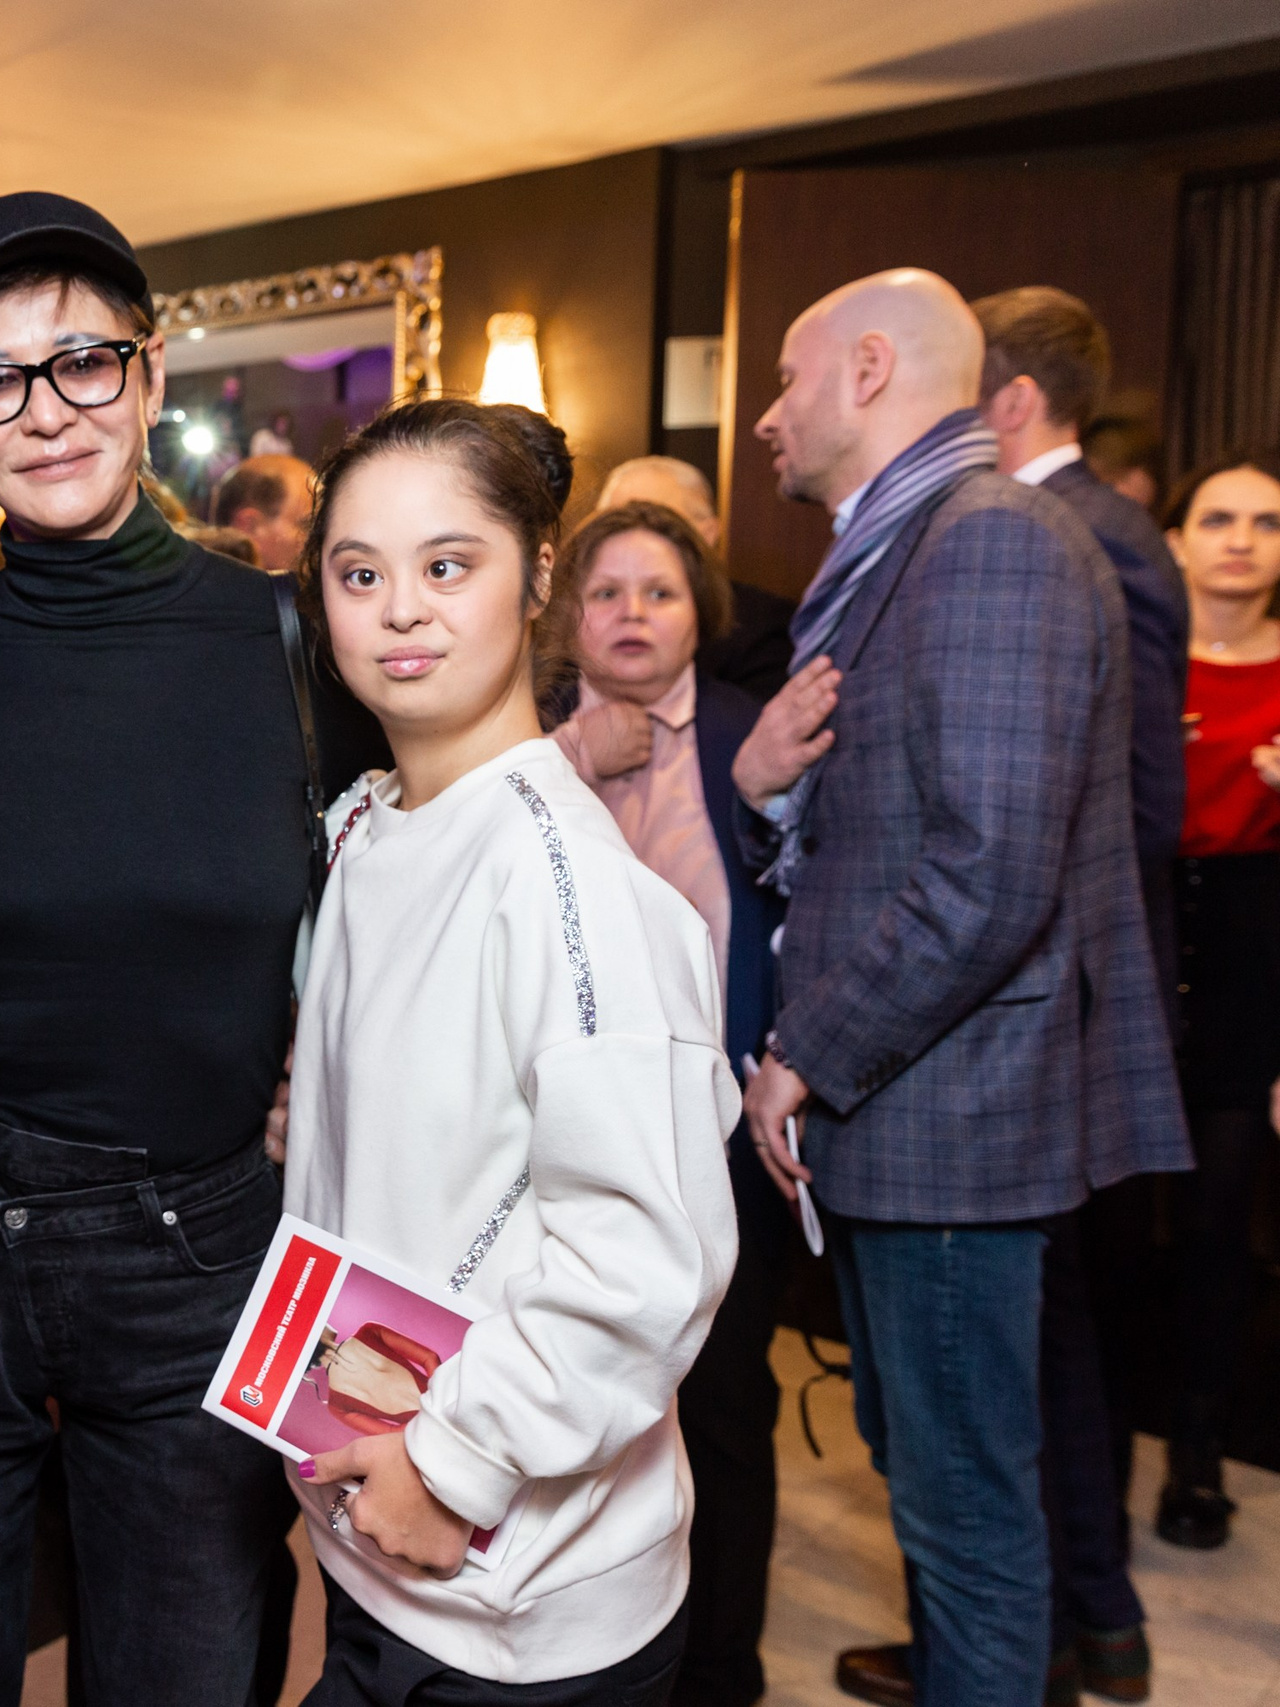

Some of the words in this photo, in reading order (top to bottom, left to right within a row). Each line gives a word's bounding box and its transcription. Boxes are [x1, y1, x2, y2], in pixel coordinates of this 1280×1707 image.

[254, 1325, 287, 1388] МОСКОВСКИЙ
[281, 1299, 297, 1326] ТЕАТР
[292, 1256, 317, 1301] МЮЗИКЛА
